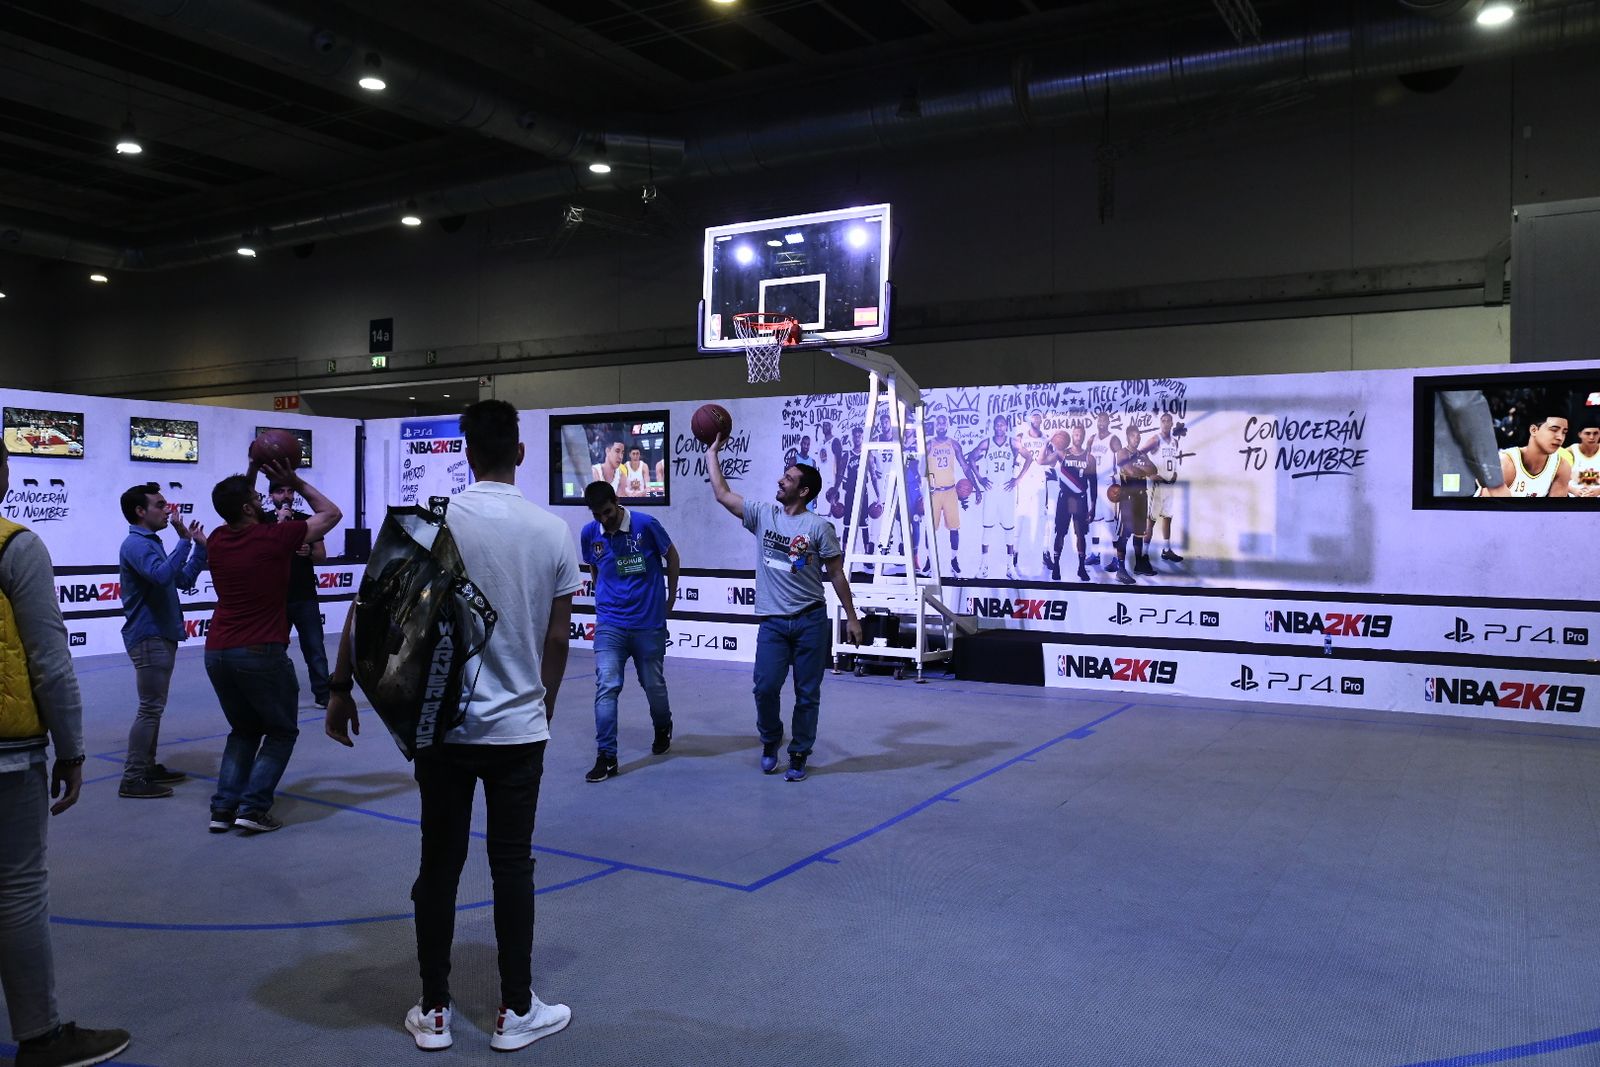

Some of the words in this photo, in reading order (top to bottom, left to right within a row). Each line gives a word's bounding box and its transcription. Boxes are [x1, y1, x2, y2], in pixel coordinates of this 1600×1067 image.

[372, 329, 389, 342] 14a
[1088, 385, 1118, 408] TRECE
[1121, 379, 1150, 398] SPIDA
[1152, 378, 1188, 399] SMOOTH
[987, 392, 1023, 416] FREAK
[1024, 390, 1060, 410] BROW
[1120, 399, 1148, 414] Take
[949, 414, 979, 426] KING
[1006, 412, 1028, 432] RISE
[1130, 415, 1153, 427] Note
[1244, 411, 1367, 444] CONOCERÁN
[413, 428, 433, 437] PS4
[410, 440, 463, 454] NBA2K19
[988, 450, 1011, 461] BUCKS
[881, 452, 893, 463] 32
[937, 457, 948, 468] 23
[1166, 459, 1173, 471] 0
[1239, 446, 1268, 471] TU
[1275, 445, 1369, 473] NOMBRE
[672, 457, 691, 477] TU
[994, 461, 1005, 473] 34
[6, 488, 69, 505] CONOCERÁN
[4, 505, 20, 519] TU
[23, 505, 70, 520] NOMBRE
[764, 530, 791, 545] MARIO
[617, 556, 643, 566] GOHUB
[974, 597, 1068, 621] NBA2K19
[1139, 608, 1195, 626] PS4
[1273, 610, 1393, 638] NBA2K19
[1484, 623, 1556, 643] PS4
[1566, 630, 1586, 643] Pro
[679, 632, 719, 650] PS4
[424, 621, 455, 700] WARNER
[1065, 654, 1178, 684] NBA2K19
[1267, 671, 1334, 693] PS4
[1343, 680, 1361, 692] Pro
[1434, 677, 1586, 713] NBA2K19
[416, 700, 443, 749] BROS
